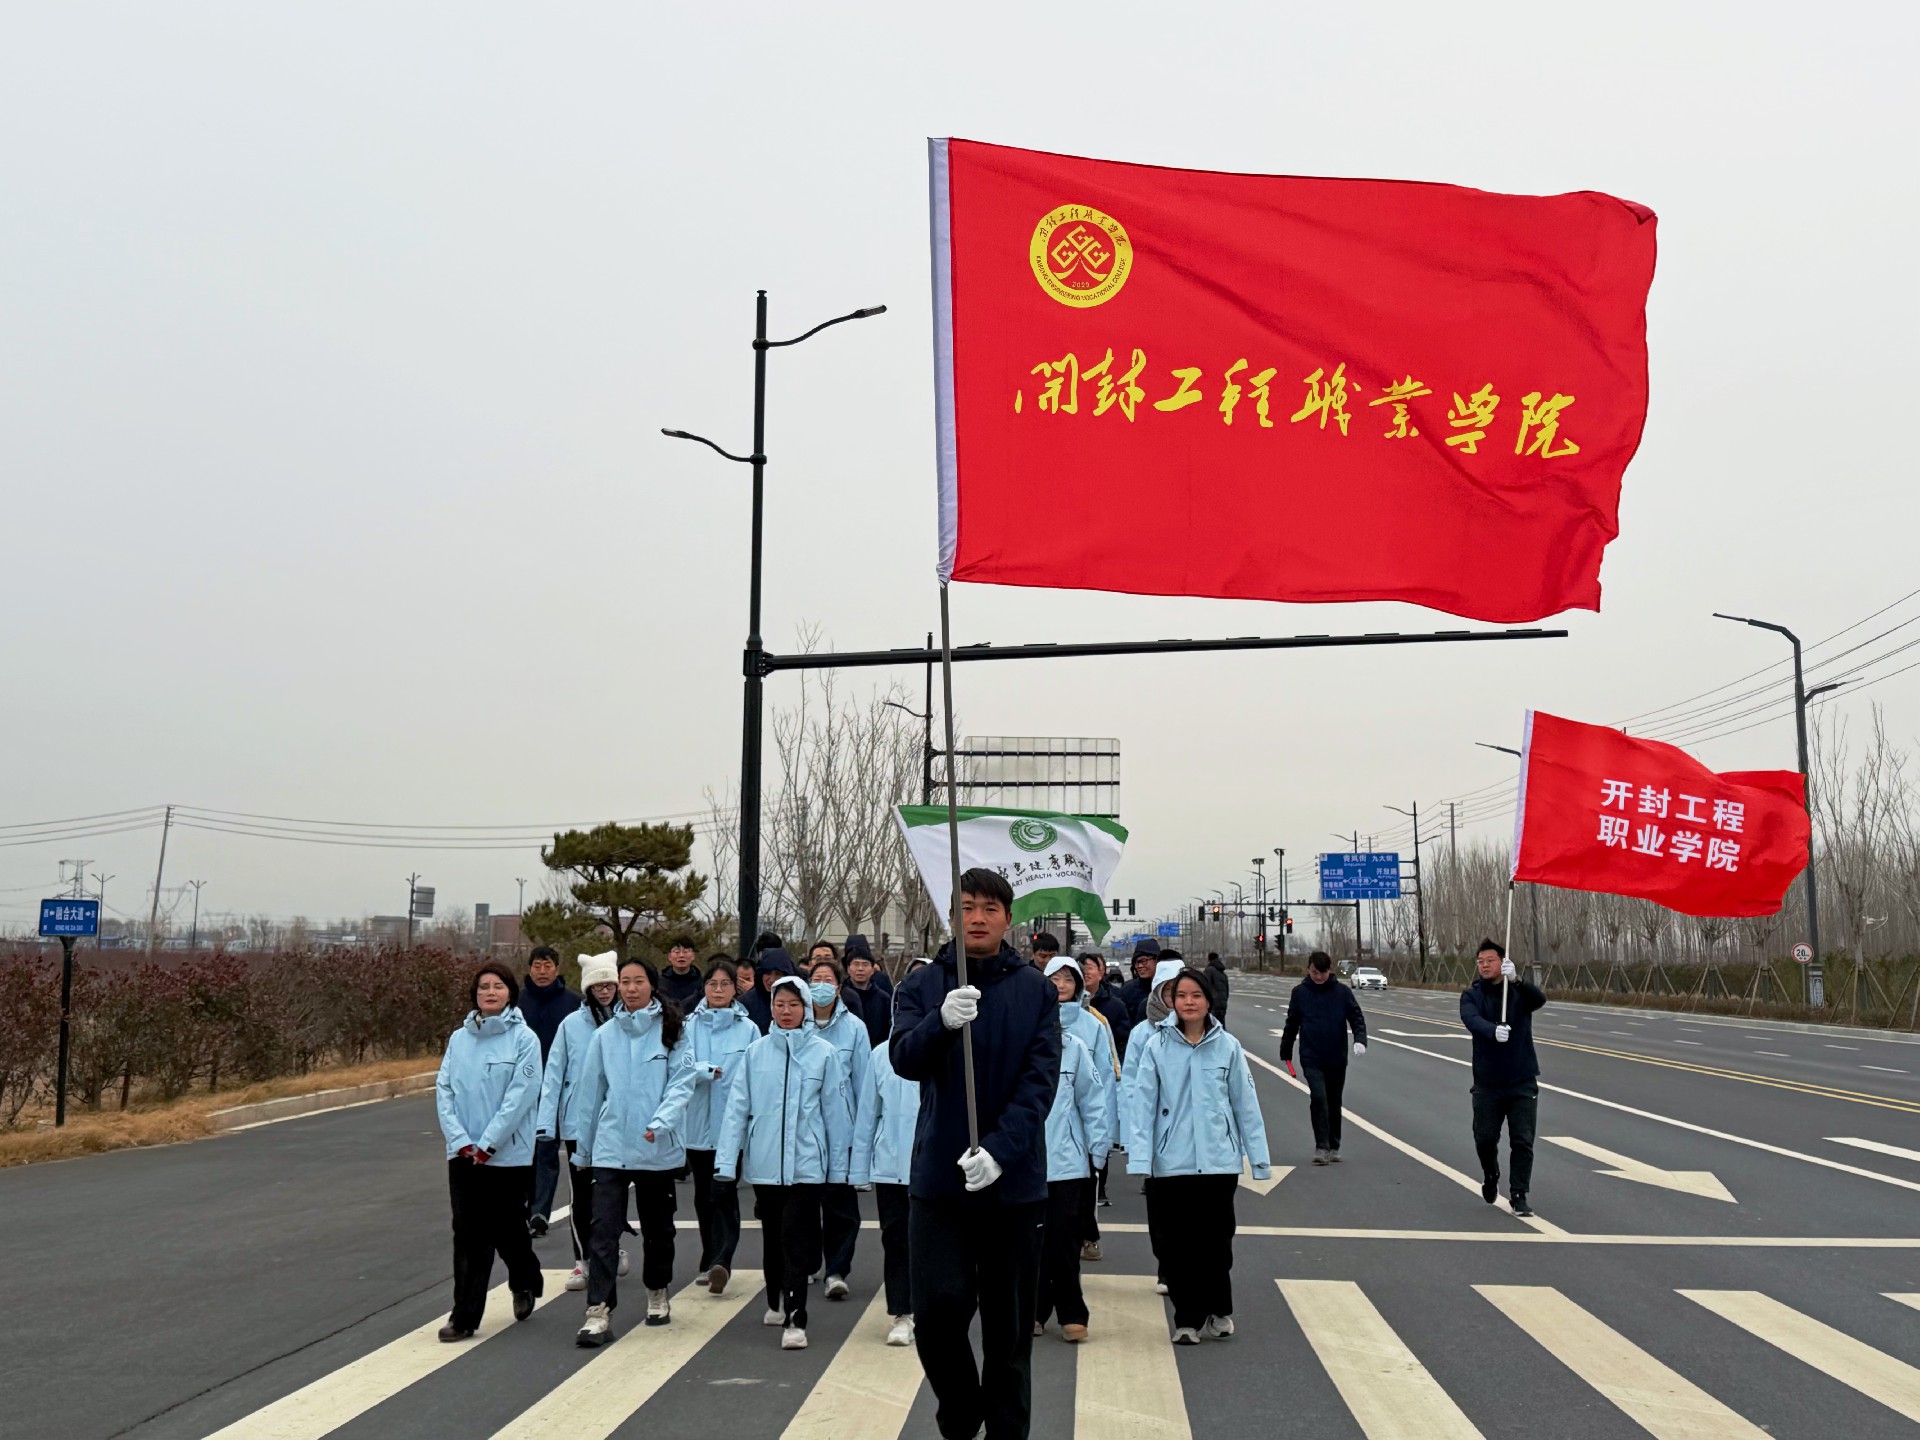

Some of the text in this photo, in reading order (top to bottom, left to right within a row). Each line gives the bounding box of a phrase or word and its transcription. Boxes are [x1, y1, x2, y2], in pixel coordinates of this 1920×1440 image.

[1600, 779, 1745, 834] 开封工程
[1596, 814, 1741, 873] 职业学院
[1025, 873, 1052, 883] HEALTH
